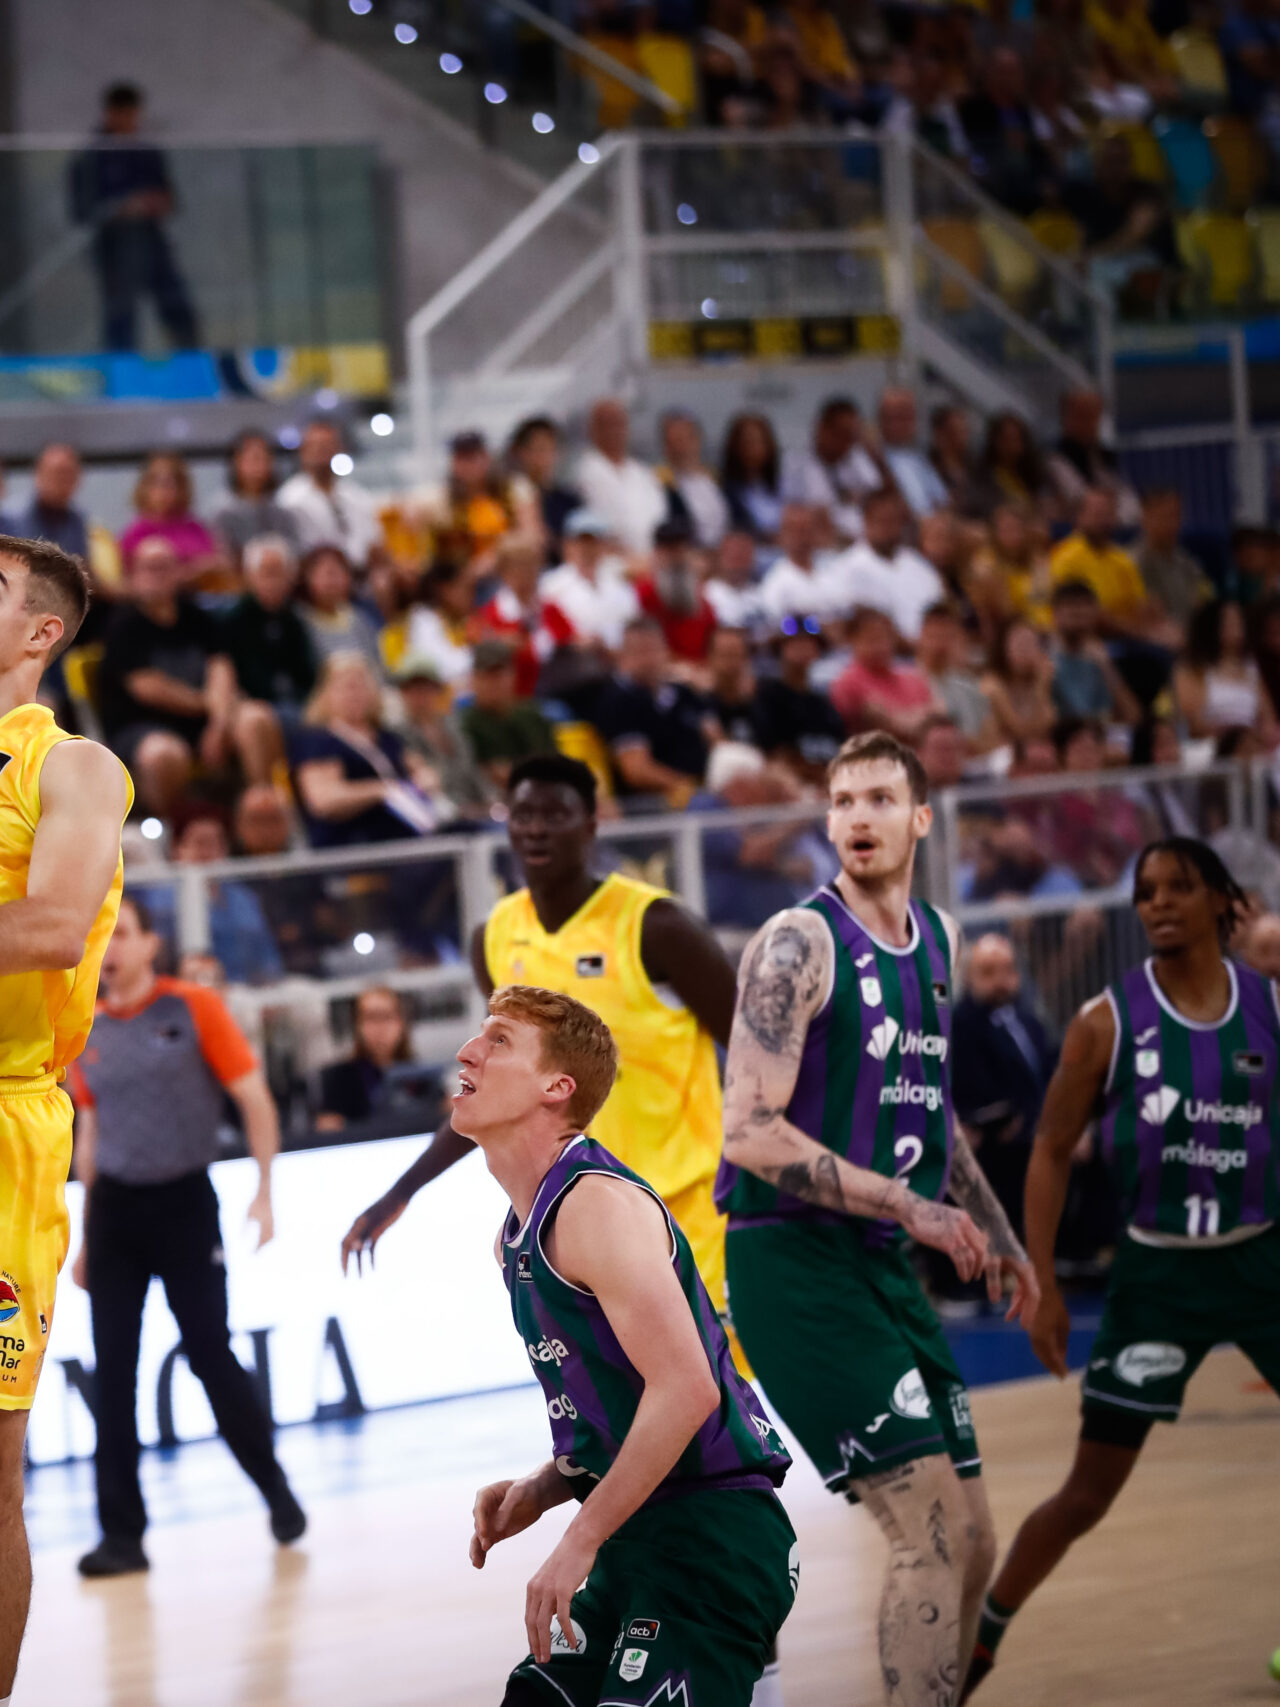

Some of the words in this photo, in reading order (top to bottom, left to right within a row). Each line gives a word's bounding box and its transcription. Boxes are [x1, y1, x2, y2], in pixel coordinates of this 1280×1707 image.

[1184, 1098, 1263, 1130] Unicaja
[894, 1135, 923, 1187] 2
[1161, 1138, 1248, 1174] málaga
[1184, 1194, 1219, 1238] 11
[1, 1271, 21, 1294] NATURE
[528, 1334, 570, 1367] caja
[630, 1627, 650, 1637] acb
